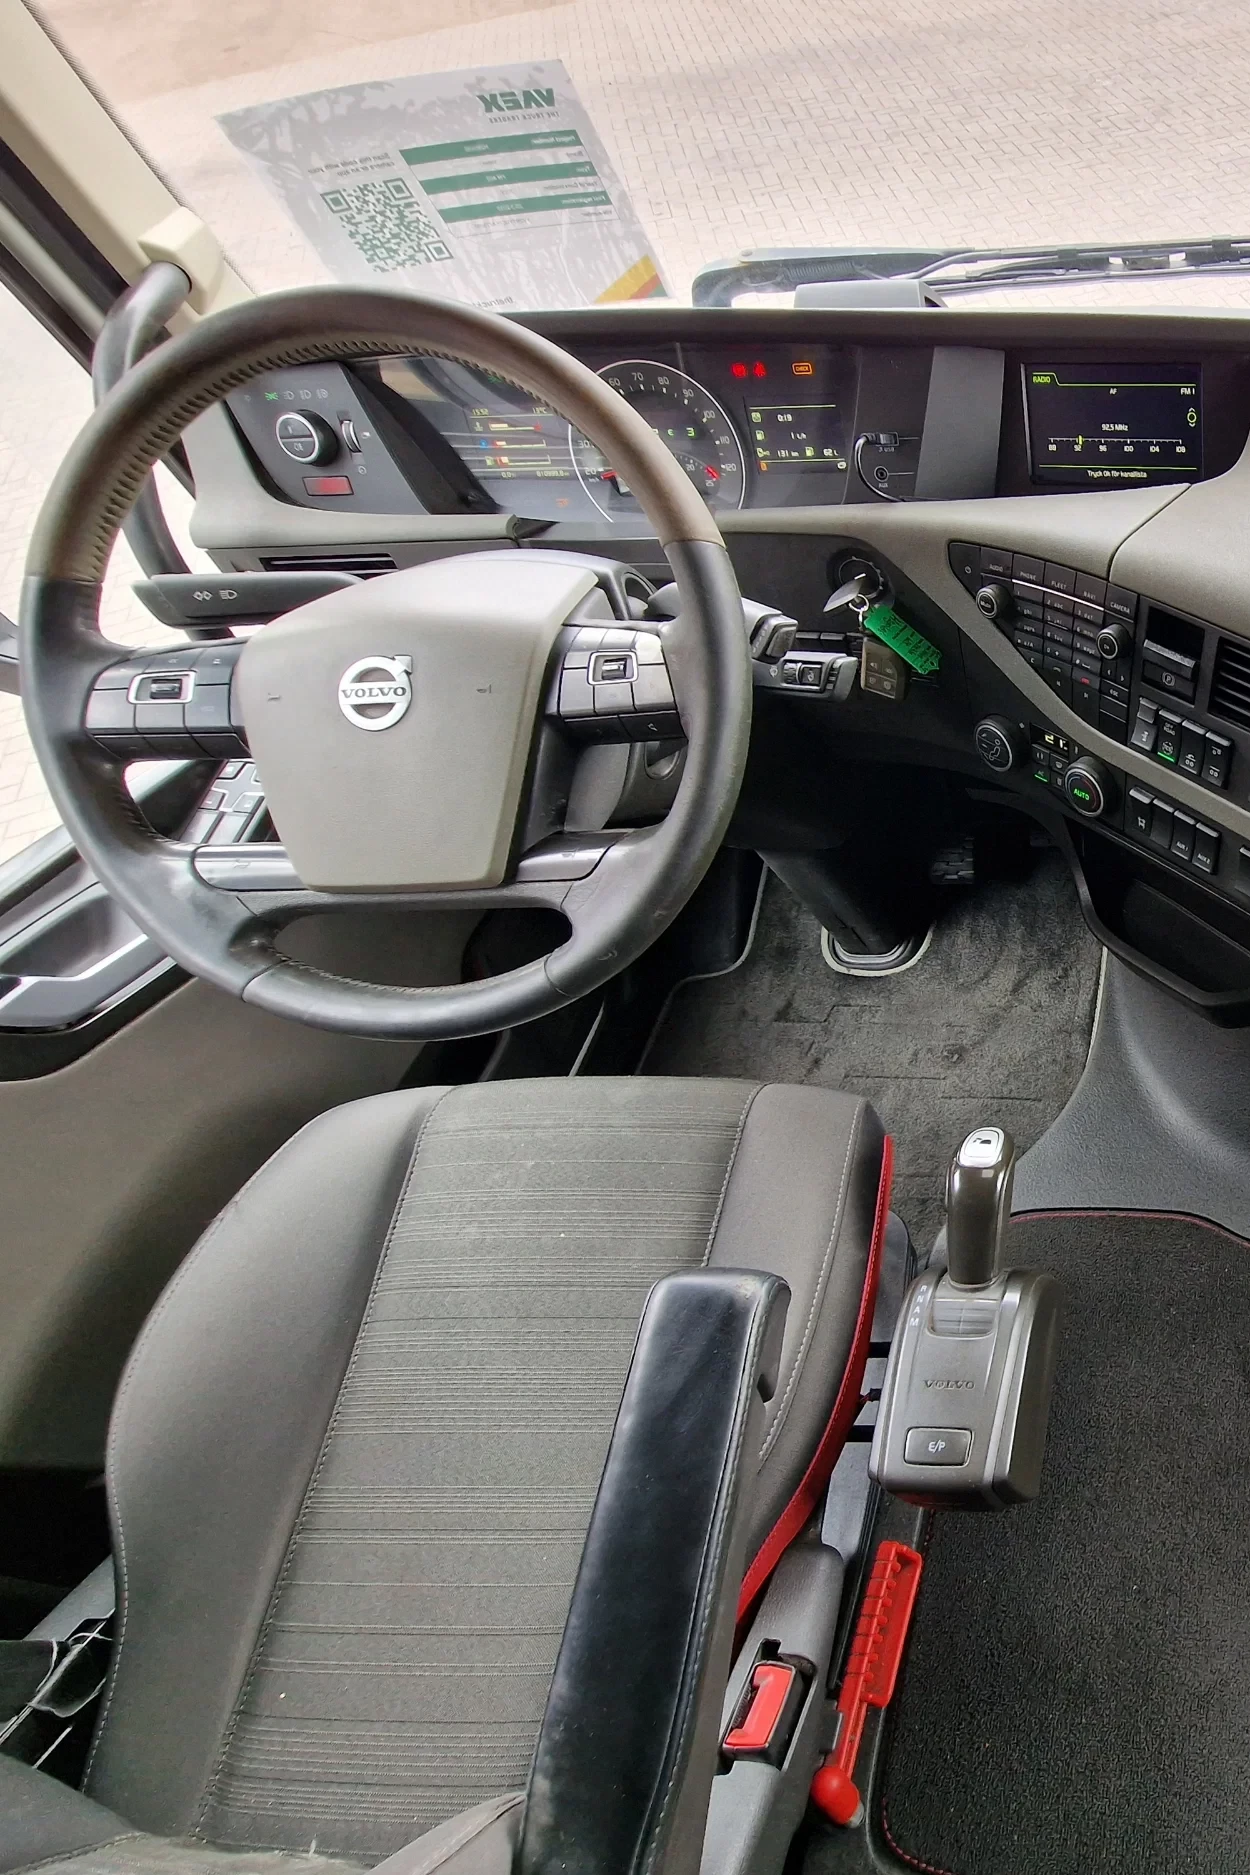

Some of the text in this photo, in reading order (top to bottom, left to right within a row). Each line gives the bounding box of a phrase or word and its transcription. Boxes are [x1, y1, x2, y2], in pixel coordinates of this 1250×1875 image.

[632, 373, 644, 381] 70
[657, 376, 670, 385] 80
[1032, 376, 1051, 384] RADIO
[608, 378, 621, 387] 60
[682, 388, 694, 398] 90
[703, 410, 715, 419] 100
[686, 427, 695, 437] 3
[578, 440, 590, 449] 30
[720, 436, 730, 444] 110
[1149, 445, 1160, 453] 104
[725, 463, 736, 472] 120
[989, 563, 1004, 572] AUDIO
[1019, 571, 1037, 581] PHONE
[1051, 580, 1067, 590] FLEET
[1083, 591, 1097, 600] NAVI
[1110, 601, 1131, 614] CAMERA
[340, 686, 407, 699] VOLVO
[1073, 788, 1090, 801] AUTO
[920, 1284, 928, 1292] R
[916, 1295, 925, 1303] N
[913, 1306, 920, 1314] A
[909, 1317, 919, 1327] M
[924, 1379, 975, 1390] VOLVO
[928, 1441, 946, 1453] E/P
